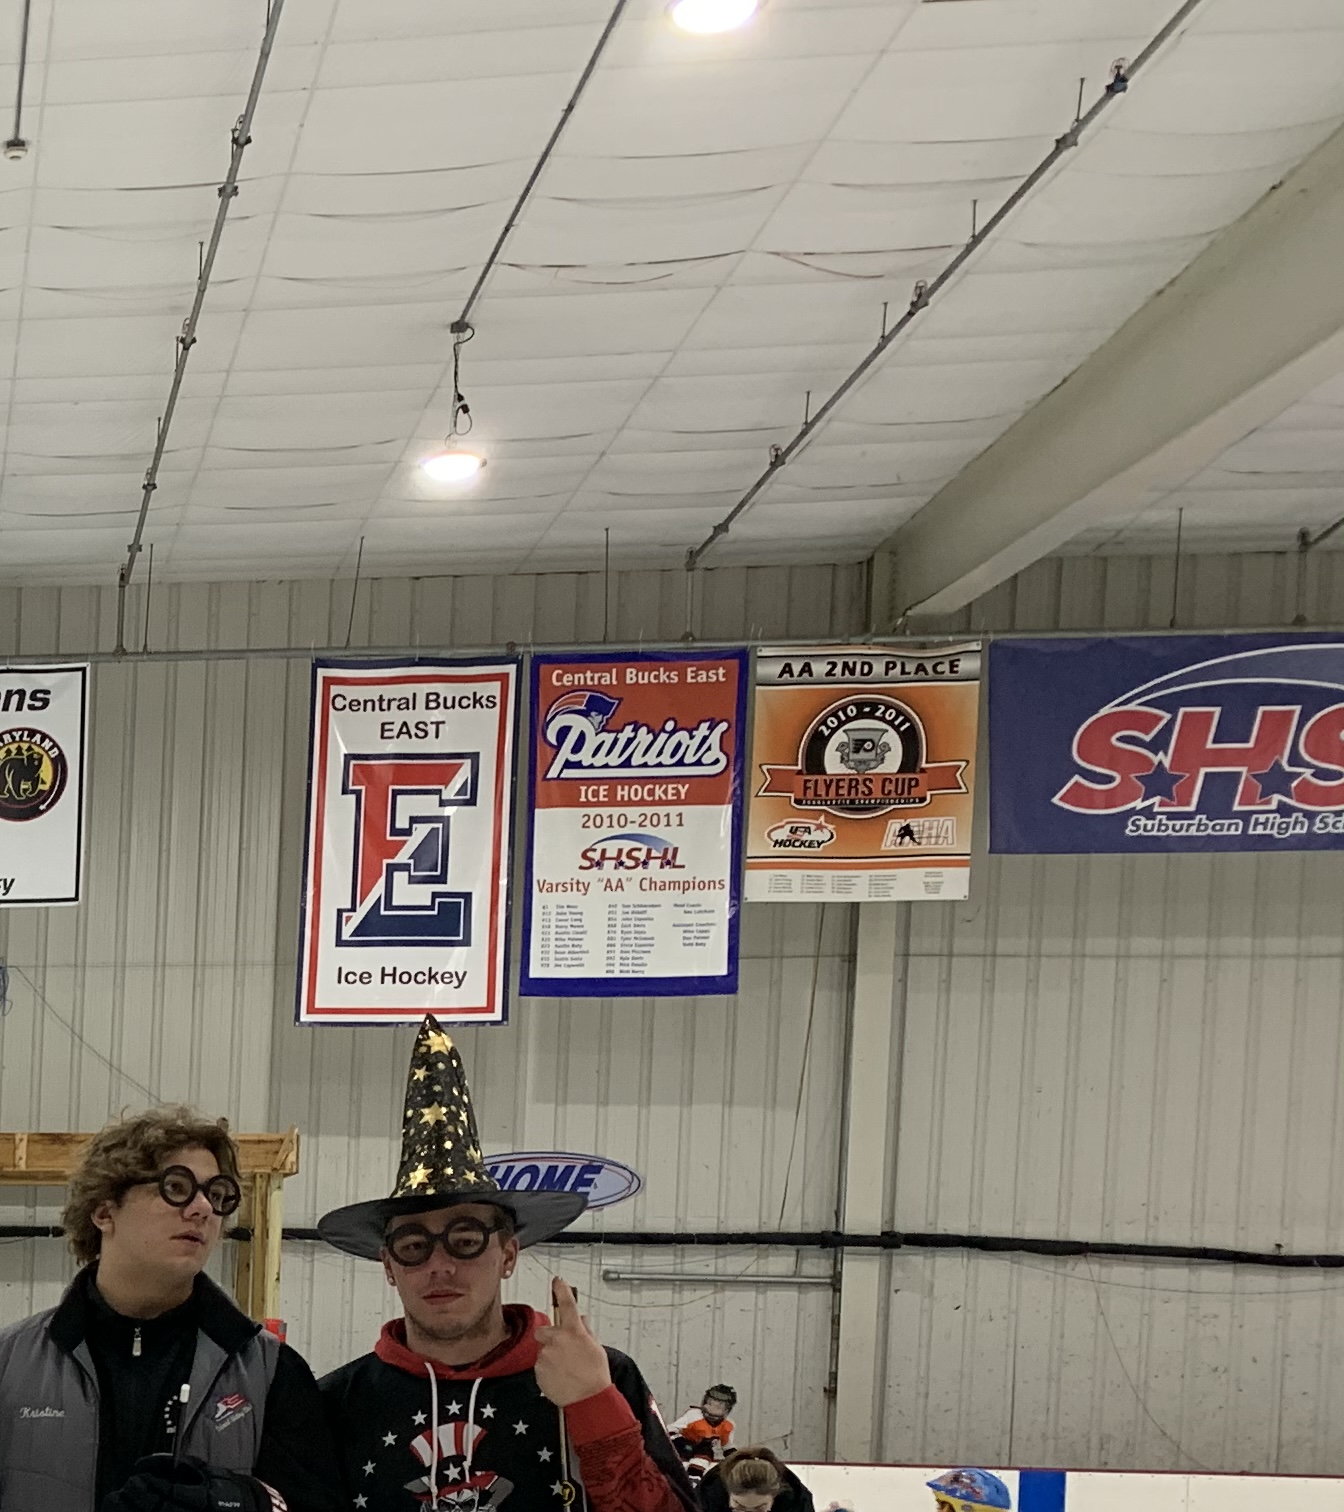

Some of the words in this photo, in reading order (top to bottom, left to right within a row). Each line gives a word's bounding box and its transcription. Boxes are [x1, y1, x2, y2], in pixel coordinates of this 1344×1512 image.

[551, 668, 618, 686] Central
[625, 667, 679, 685] Bucks
[686, 666, 727, 683] East
[777, 661, 814, 678] AA
[824, 660, 874, 677] 2ND
[884, 658, 961, 677] PLACE
[331, 692, 417, 713] Central
[425, 690, 498, 711] Bucks
[379, 720, 446, 740] EAST
[817, 705, 858, 737] 2010
[874, 704, 912, 732] 2011
[544, 712, 730, 780] Patriots
[579, 785, 609, 802] ICE
[616, 784, 689, 801] HOCKEY
[802, 777, 874, 798] FLYERS
[880, 776, 920, 797] CUP
[581, 812, 685, 829] 2010-2011
[1126, 815, 1243, 835] Suburban
[1248, 813, 1309, 838] High
[772, 838, 827, 849] HOCKEY
[578, 846, 686, 870] SHSHL
[537, 877, 591, 896] Varsity
[639, 876, 726, 895] Champions
[337, 966, 373, 985] Ice
[380, 966, 468, 989] Hockey
[488, 1164, 605, 1198] HOME
